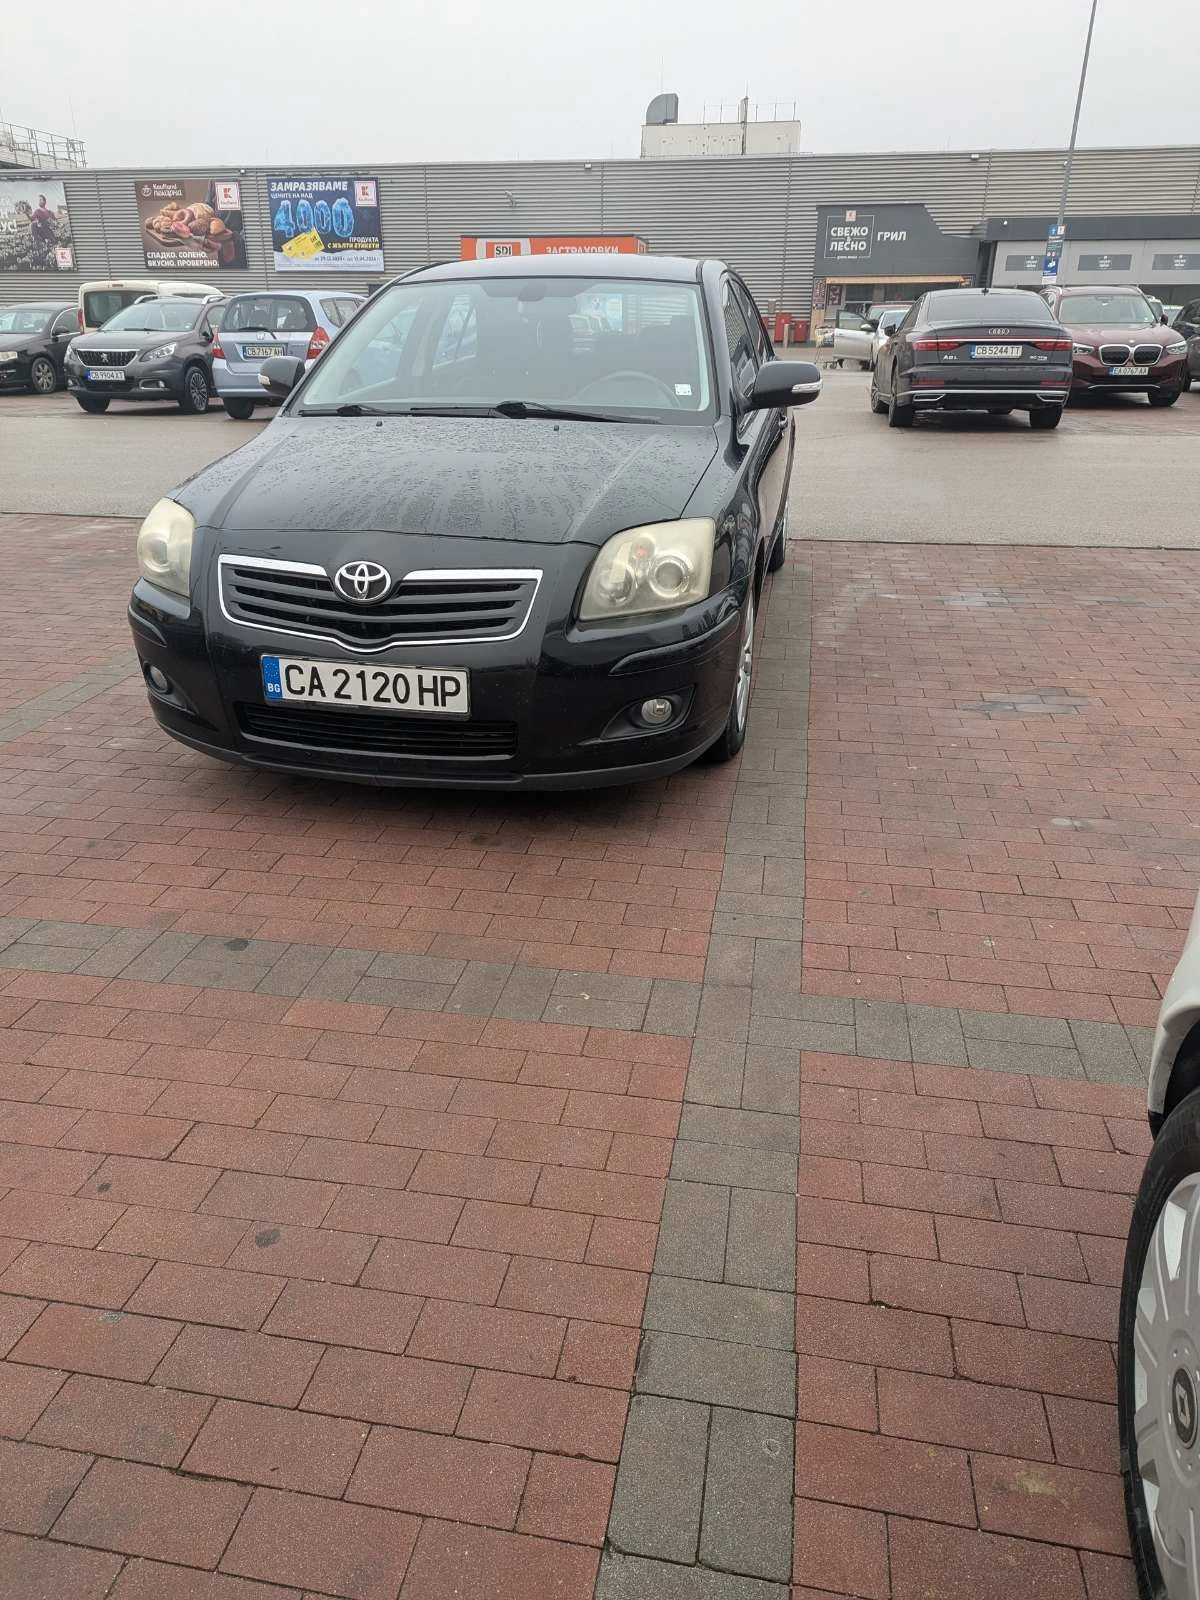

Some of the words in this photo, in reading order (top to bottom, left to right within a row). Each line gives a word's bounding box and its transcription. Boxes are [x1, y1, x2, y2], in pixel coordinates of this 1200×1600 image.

[270, 181, 349, 192] ЗАМРАЗЯВАМЕ
[274, 197, 355, 238] 4000
[830, 226, 869, 237] СВЕЖО
[877, 231, 907, 241] ГРИЛ
[495, 246, 512, 256] SDI
[545, 245, 620, 255] ЗАСТРАХОВКИ
[829, 241, 867, 251] ЛЕСНО
[146, 251, 178, 259] СЛАДКО.
[988, 346, 1009, 355] 5244
[267, 682, 281, 693] BG
[332, 669, 410, 704] 2120
